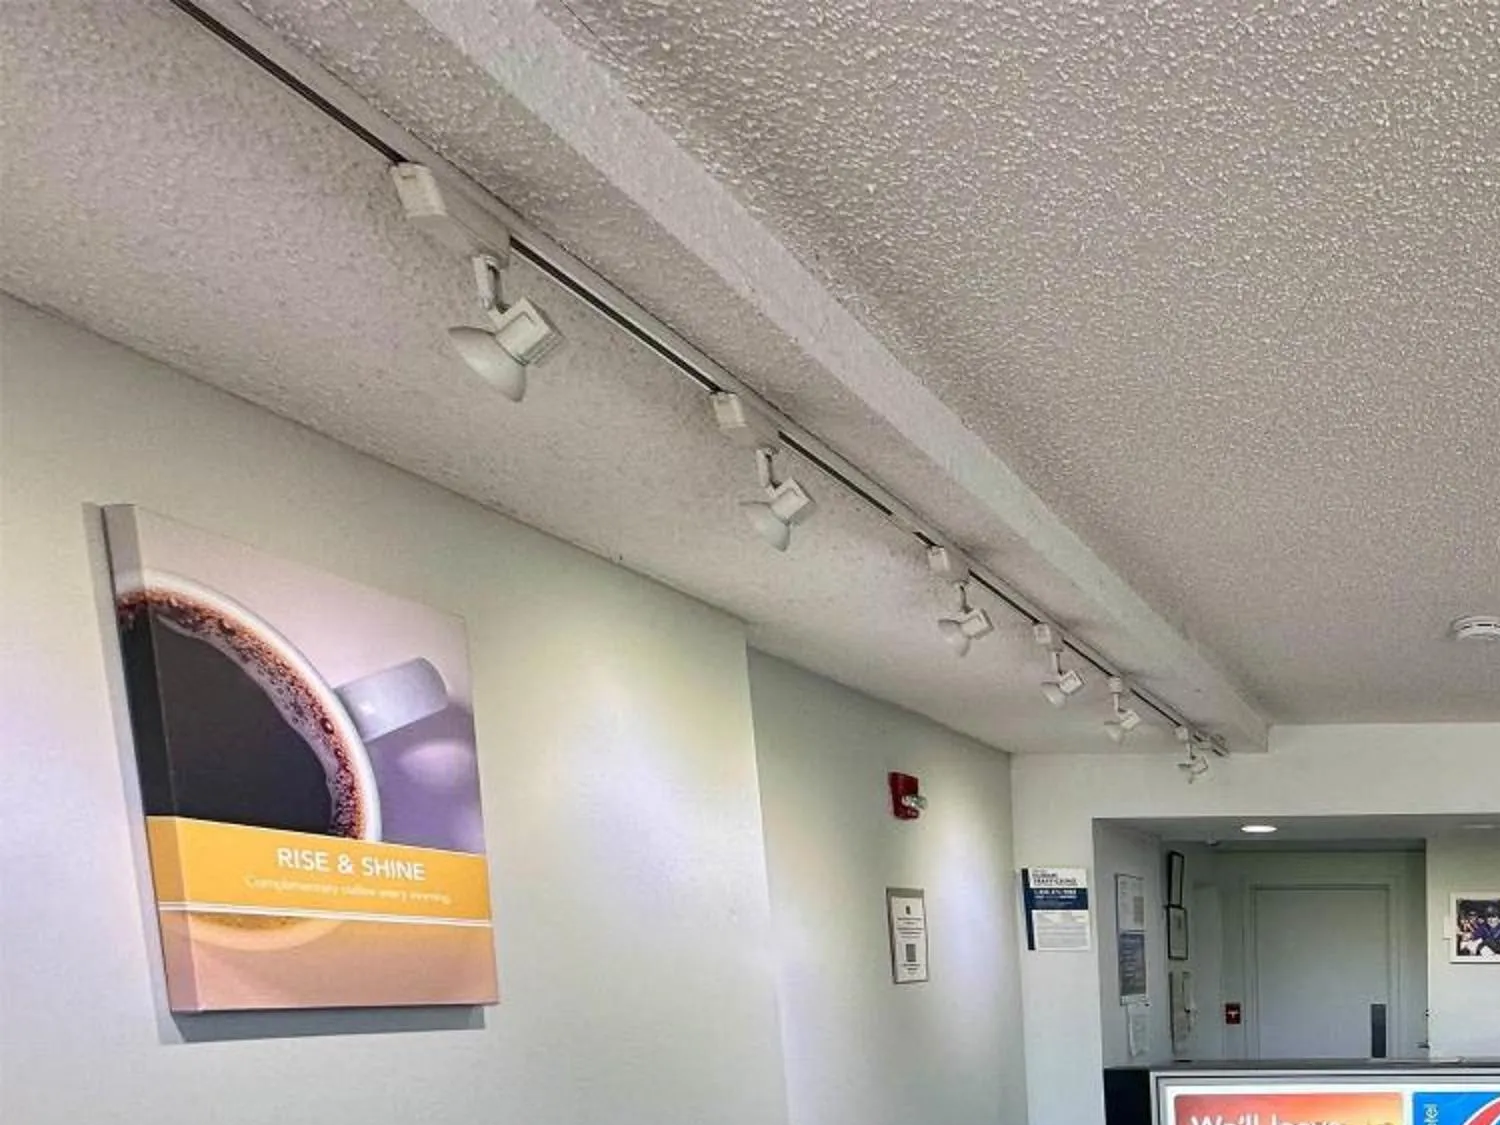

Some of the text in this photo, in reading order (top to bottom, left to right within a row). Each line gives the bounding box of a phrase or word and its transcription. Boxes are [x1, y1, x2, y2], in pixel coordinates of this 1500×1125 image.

[277, 847, 425, 881] RISE & SHINE
